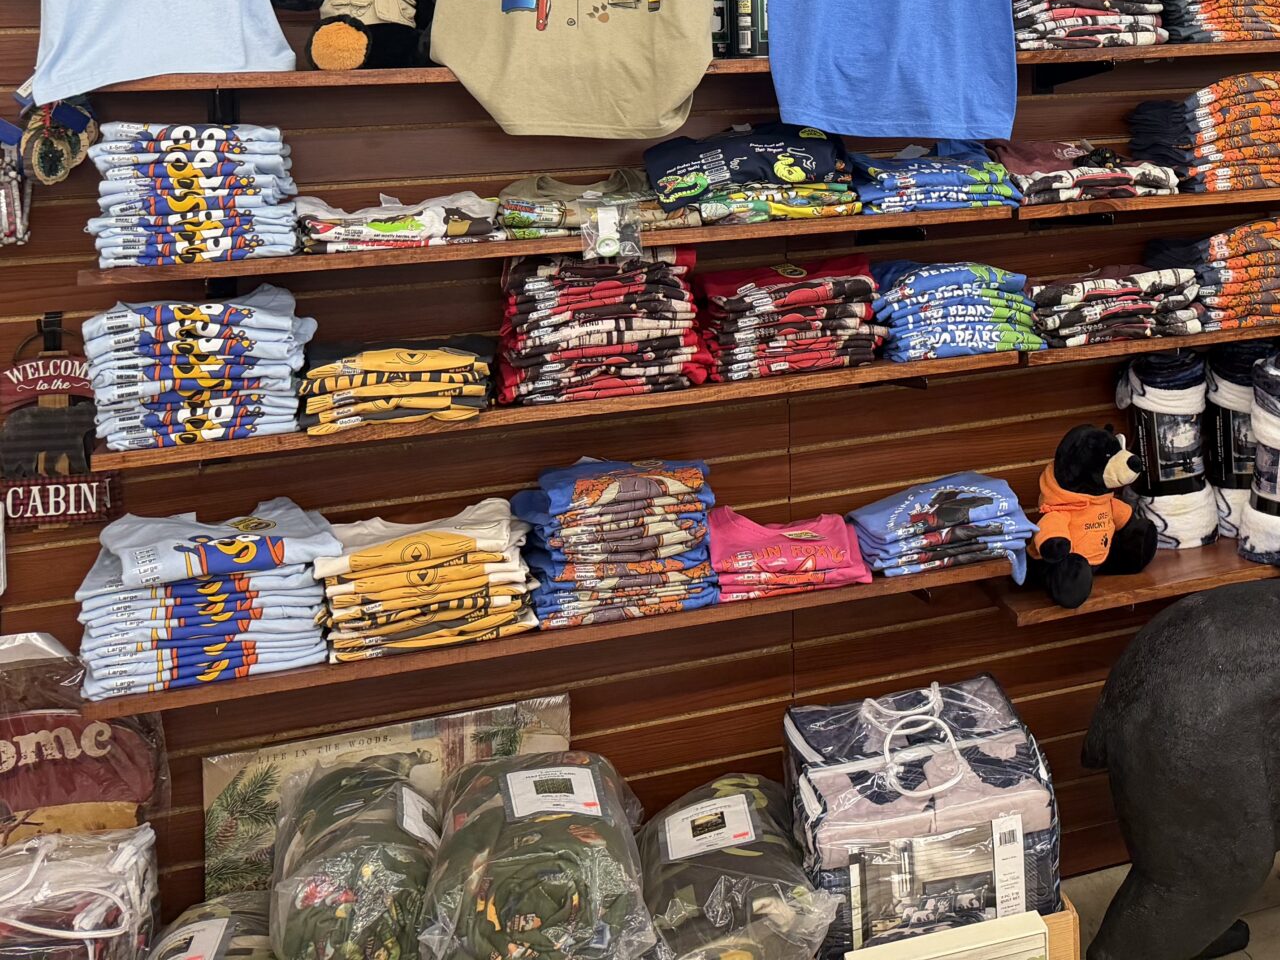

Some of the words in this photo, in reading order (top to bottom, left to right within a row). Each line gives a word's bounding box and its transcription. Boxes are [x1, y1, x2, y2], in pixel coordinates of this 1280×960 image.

[955, 330, 1000, 343] BEARS
[4, 359, 92, 385] WELCOM
[36, 379, 50, 391] to
[50, 378, 72, 391] the
[338, 417, 361, 425] Medium
[6, 482, 99, 519] CABIN
[790, 544, 845, 563] FOXY
[138, 565, 158, 574] Large
[141, 575, 160, 584] Large
[112, 604, 131, 612] Large
[107, 645, 126, 653] Large
[364, 651, 382, 659] Large
[108, 668, 128, 676] Large
[115, 679, 135, 687] Large
[258, 752, 287, 765] LIFE
[295, 750, 307, 758] IN
[317, 743, 340, 754] THE
[349, 734, 392, 748] WOODS.
